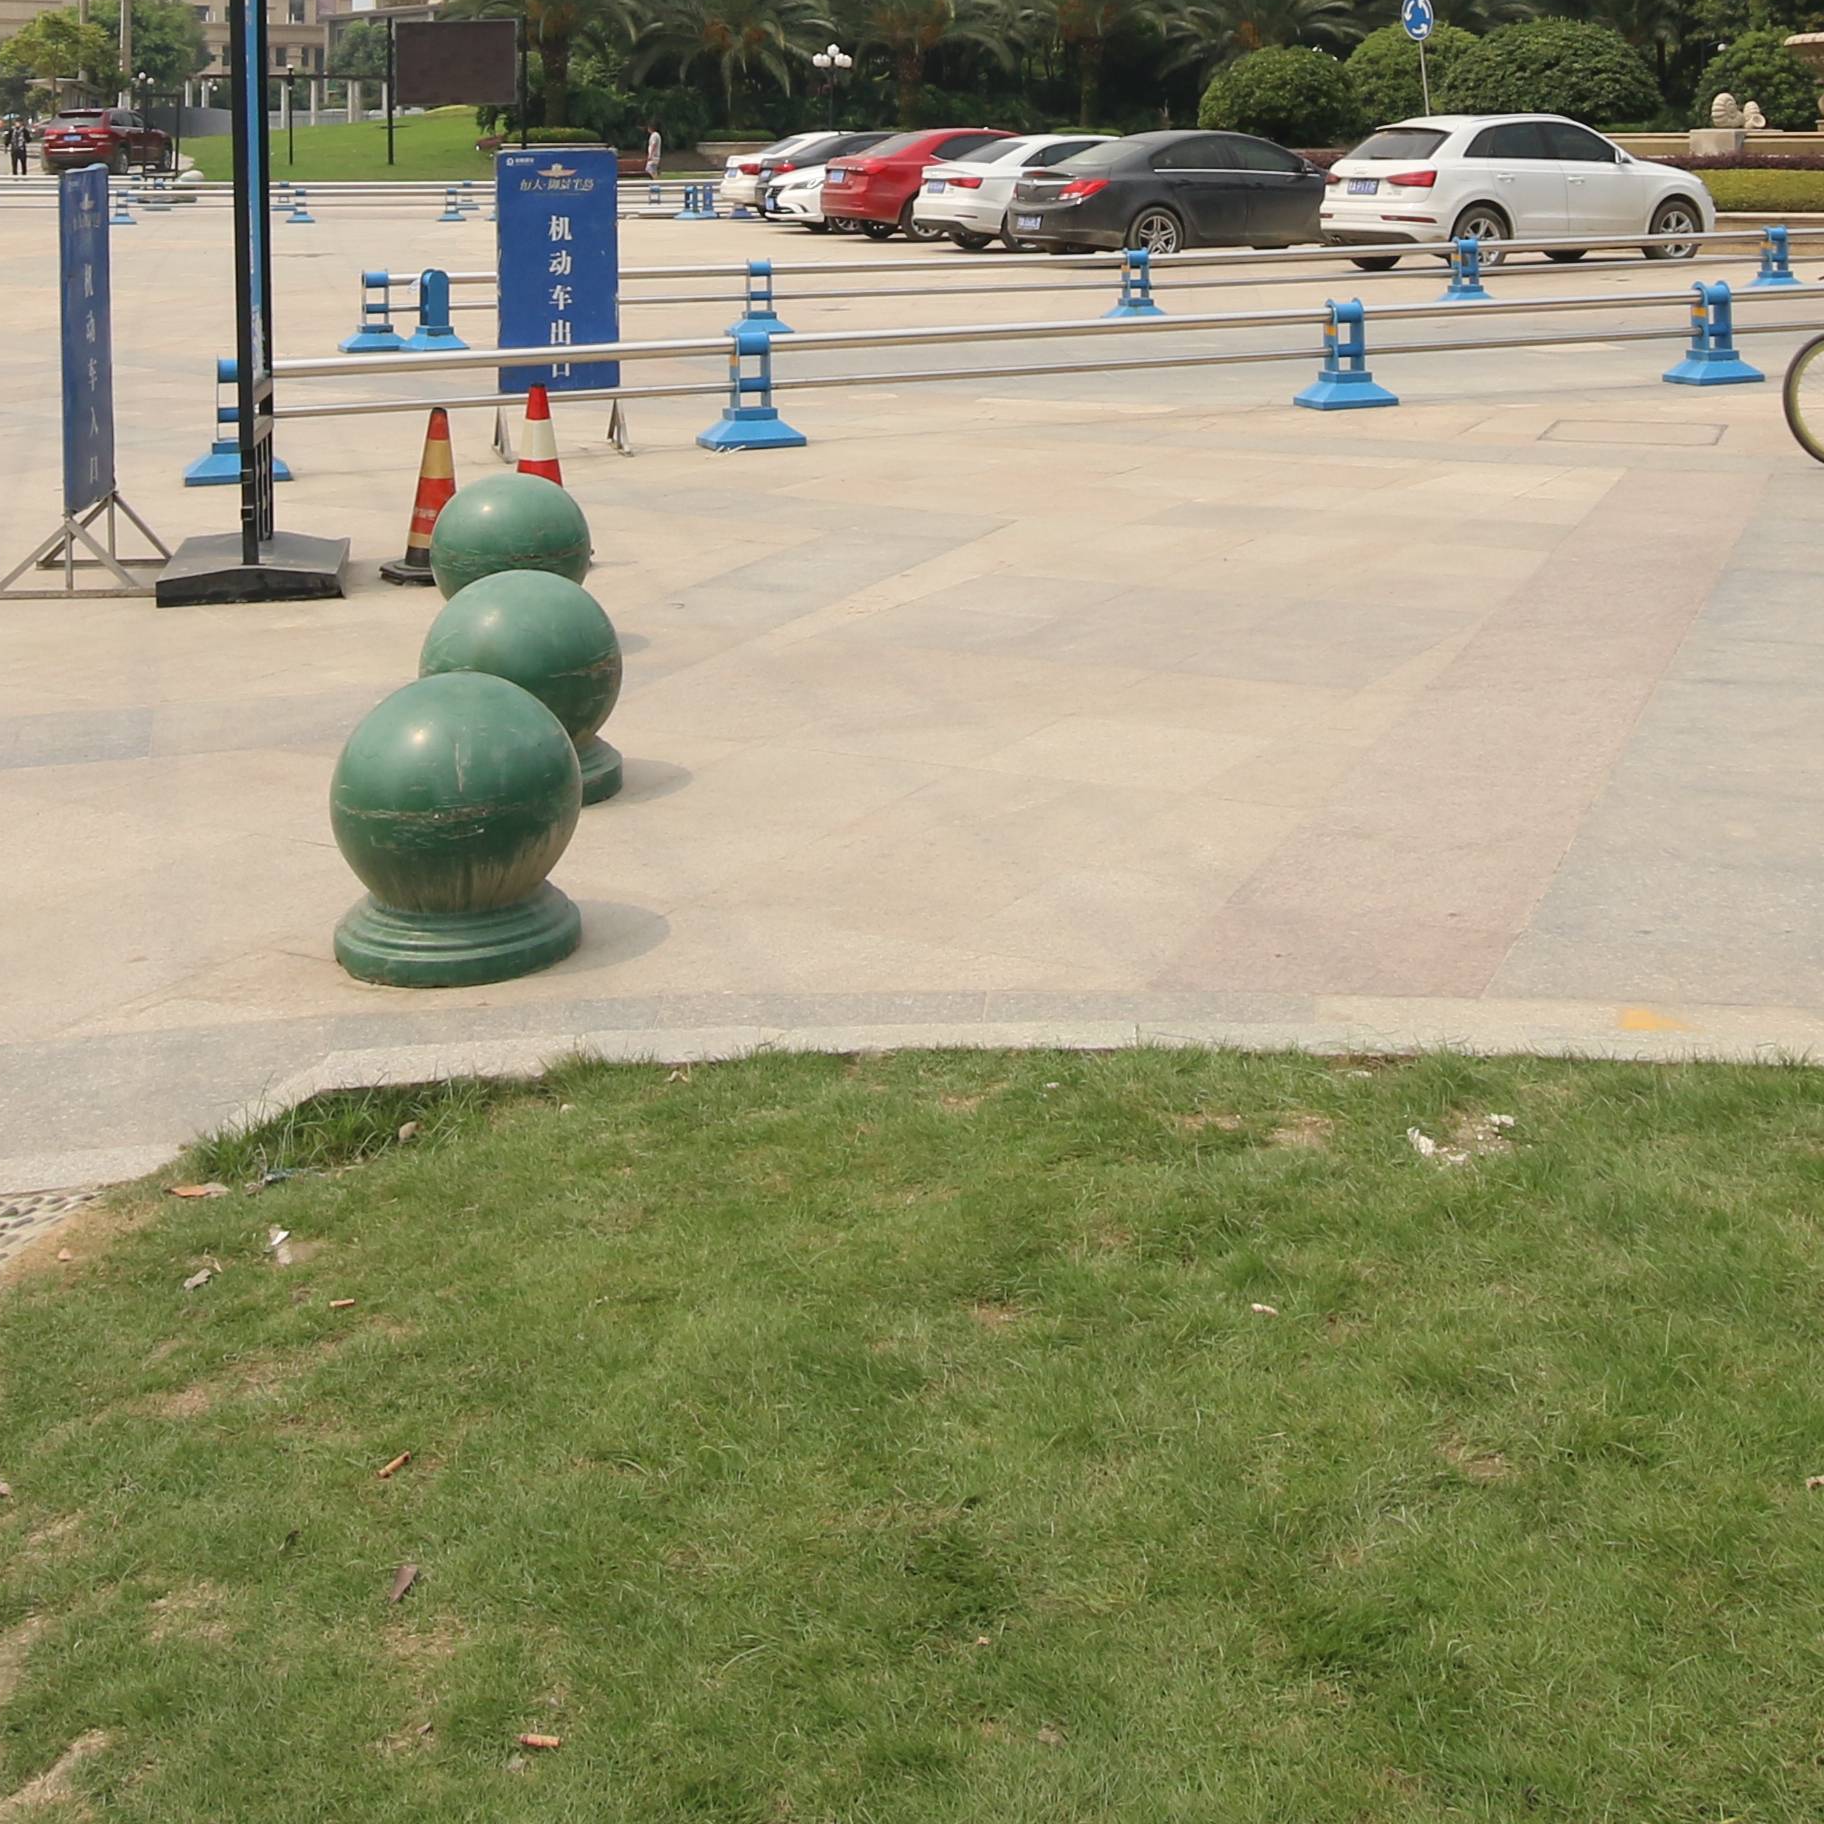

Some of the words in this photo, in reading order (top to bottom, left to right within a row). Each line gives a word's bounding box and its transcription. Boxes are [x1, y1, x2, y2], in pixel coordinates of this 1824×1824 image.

[84, 263, 99, 485] 机动车入口
